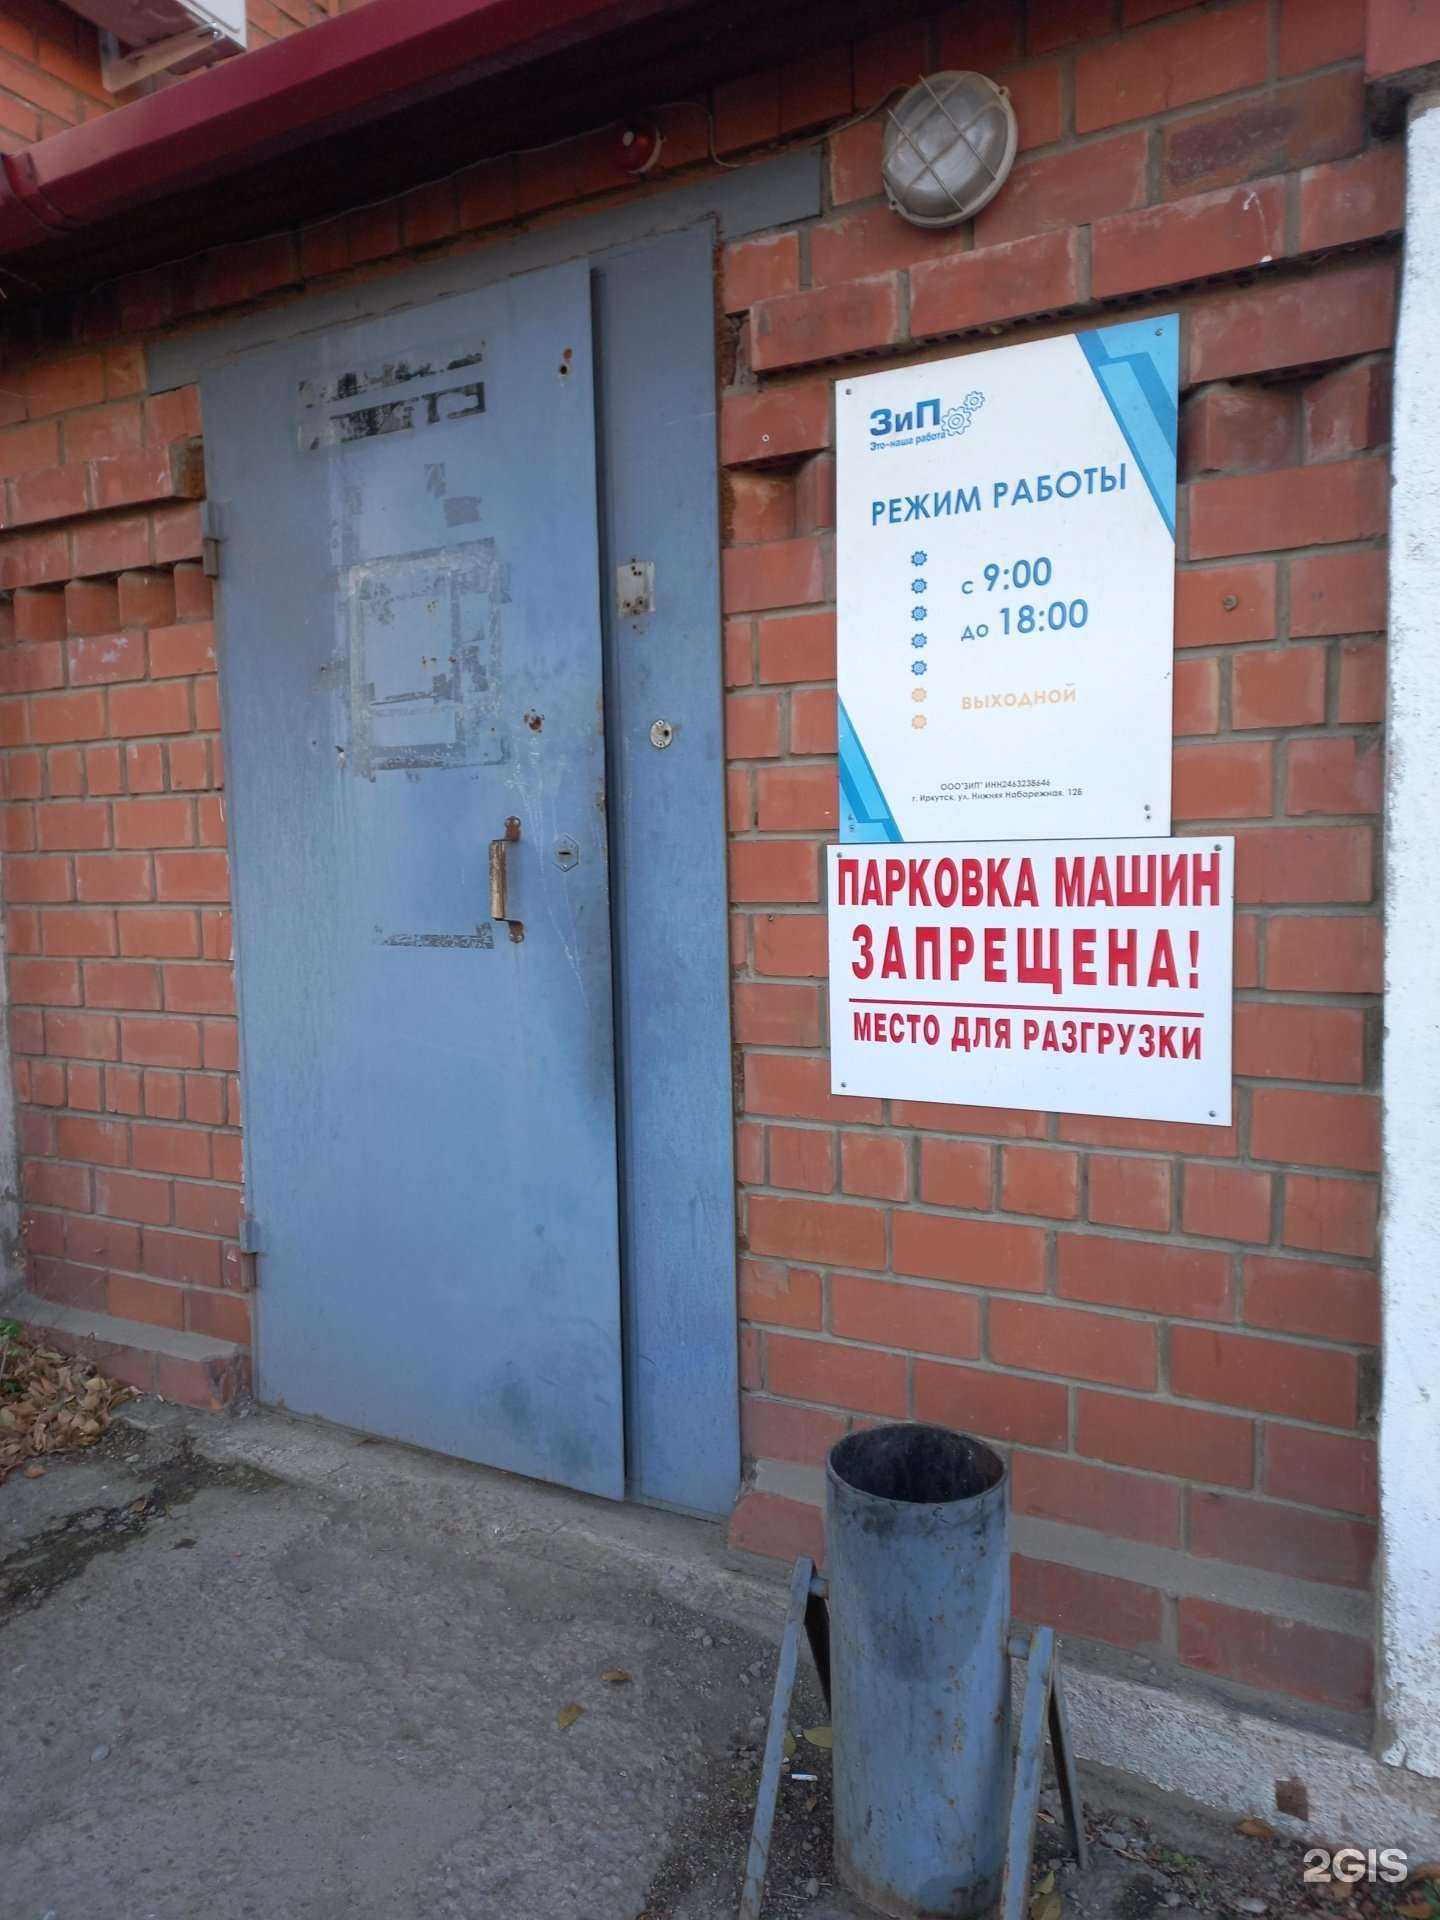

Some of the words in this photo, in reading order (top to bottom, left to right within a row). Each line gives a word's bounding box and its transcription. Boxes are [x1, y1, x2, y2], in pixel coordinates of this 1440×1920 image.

[870, 398, 940, 436] ЗиП
[915, 431, 946, 446] работа
[872, 486, 981, 526] РЕЖИМ
[994, 463, 1125, 508] РАБОТЫ
[961, 580, 974, 595] с
[984, 557, 1052, 591] 9:00
[961, 624, 989, 641] до
[1000, 599, 1088, 635] 18:00
[971, 792, 1003, 800] Нижняя
[837, 857, 1039, 908] ПАРКОВКА
[1055, 852, 1220, 907] МАШИН
[852, 924, 1199, 994] ЗАПРЕЩЕНА!
[853, 1011, 941, 1045] МЕСТО
[951, 1015, 1011, 1052] ДЛЯ
[1023, 1018, 1203, 1060] РАЗГРУЗКИ
